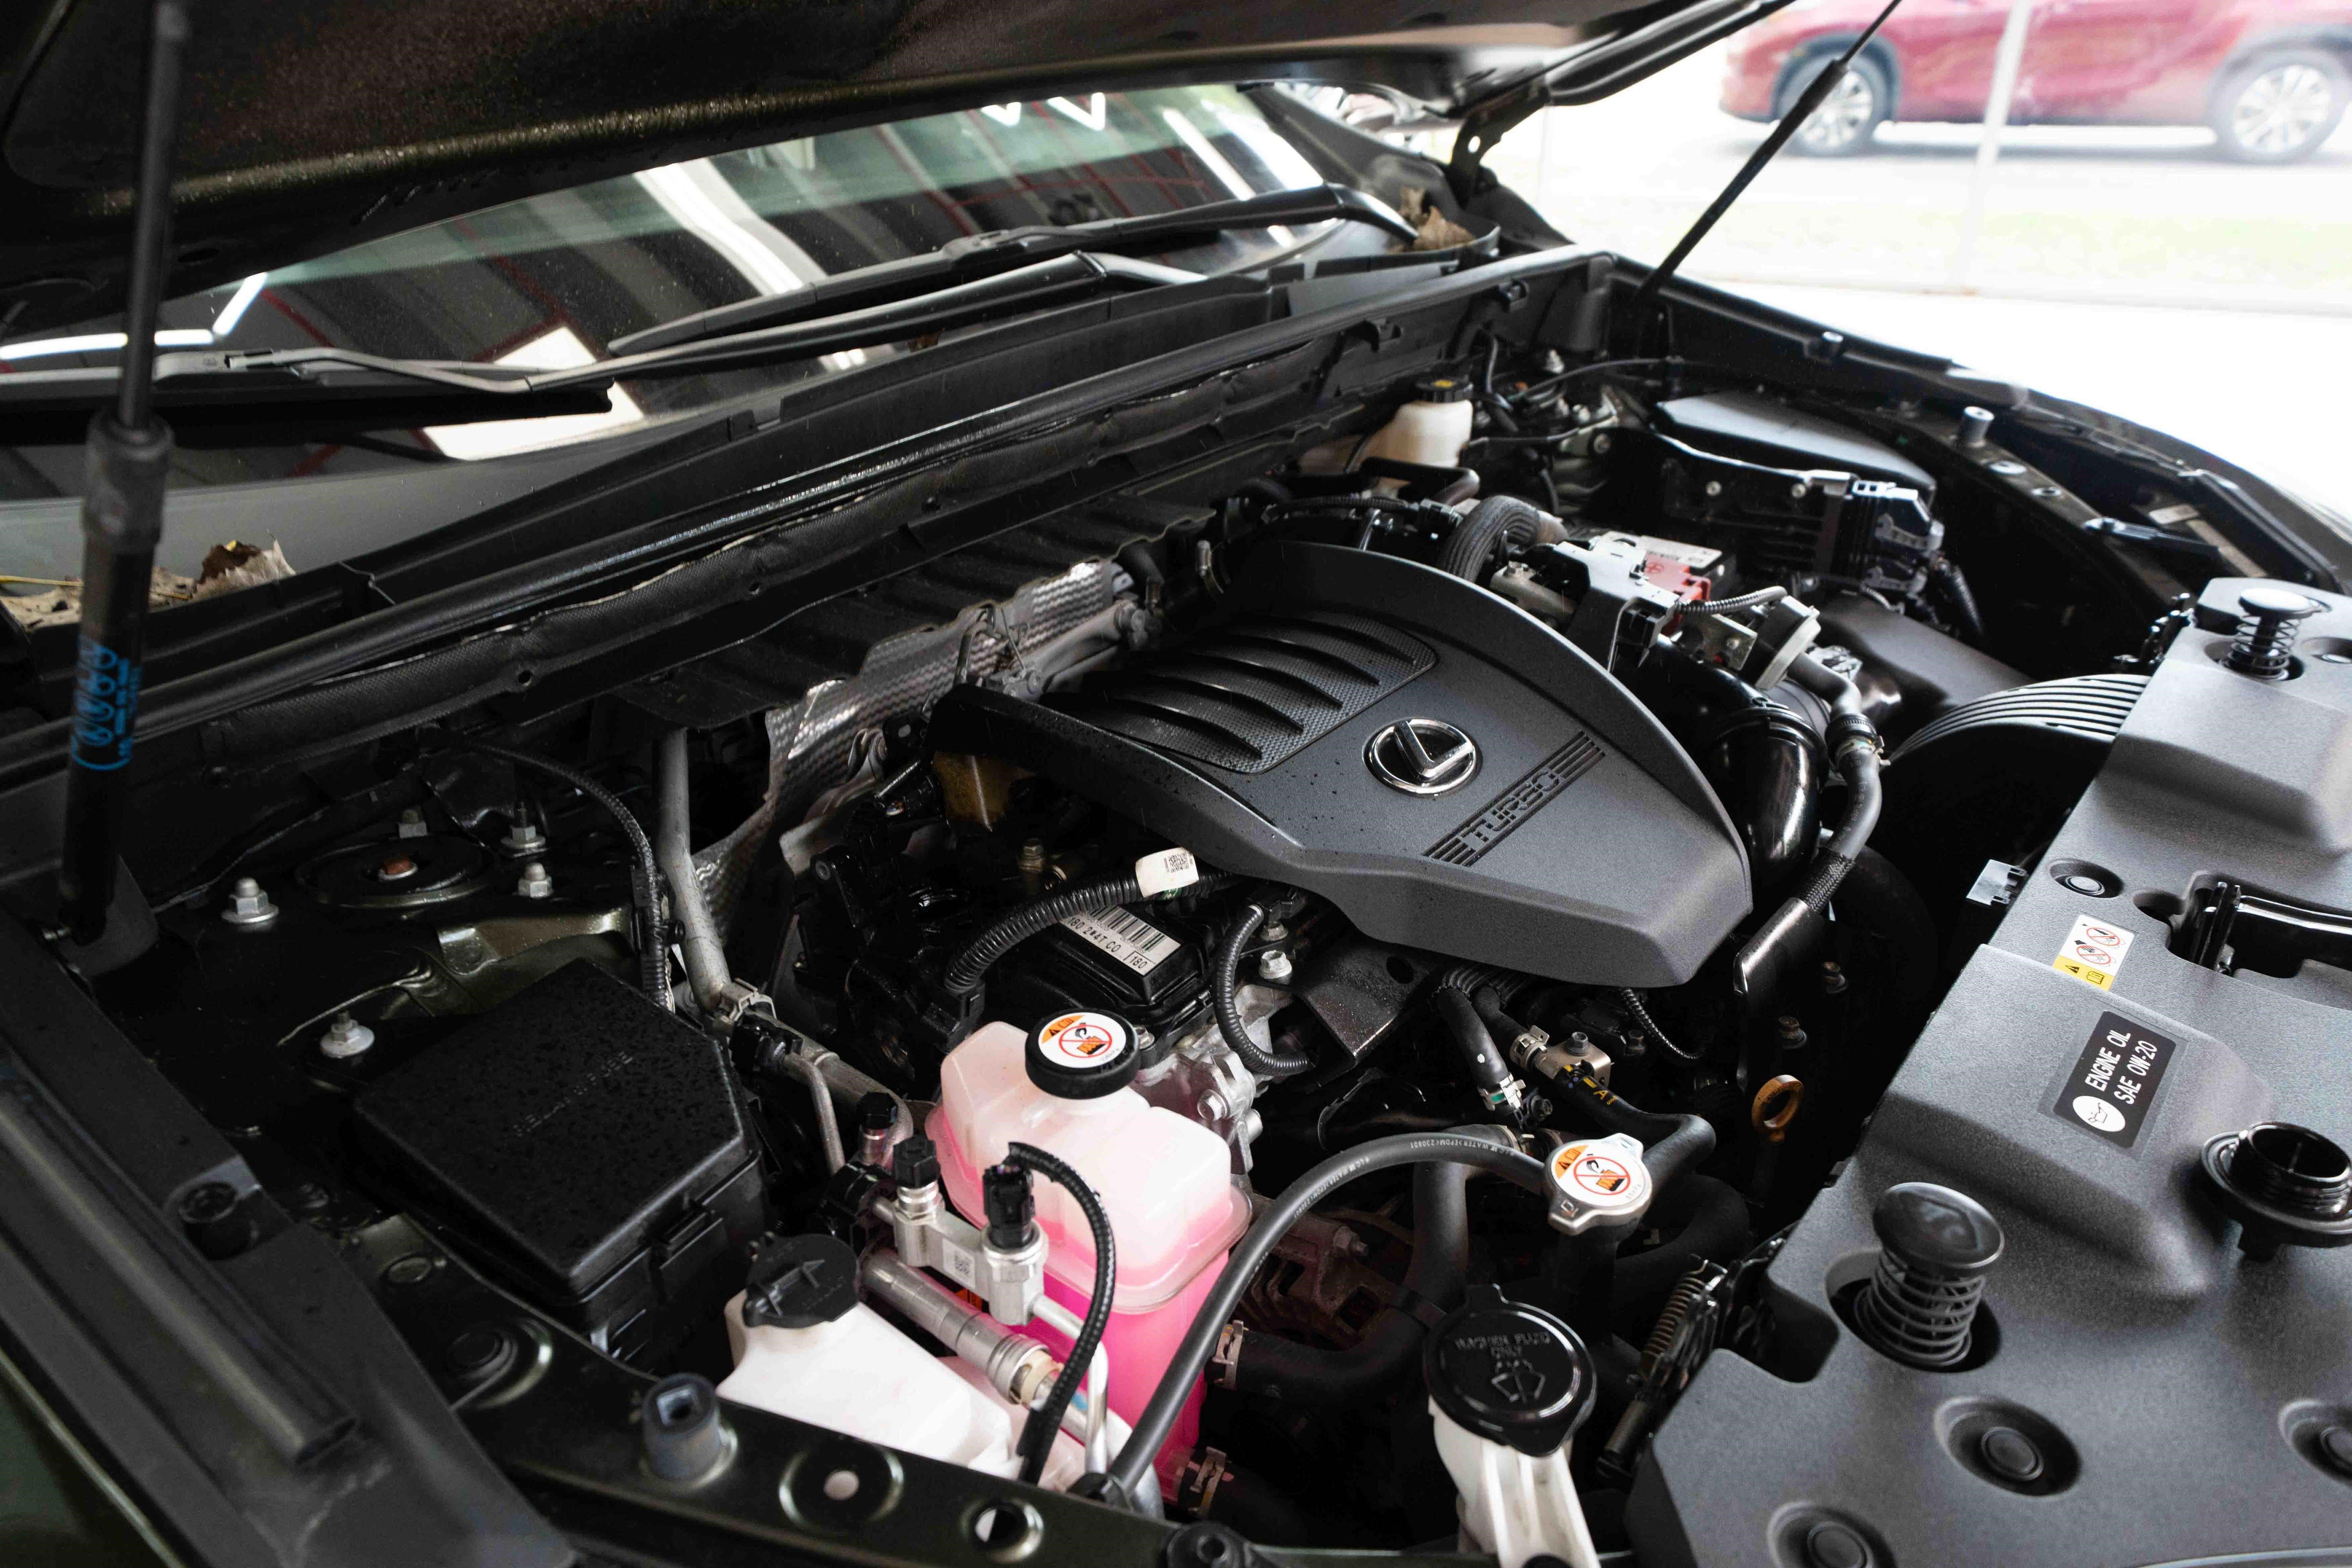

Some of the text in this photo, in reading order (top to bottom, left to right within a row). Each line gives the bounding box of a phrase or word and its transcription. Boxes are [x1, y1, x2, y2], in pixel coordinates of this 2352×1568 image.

[1460, 768, 1560, 842] TURBO
[1129, 956, 1148, 969] 180
[2085, 1030, 2131, 1091] ENGINE OIL
[2114, 1040, 2157, 1105] SAE 0W-20
